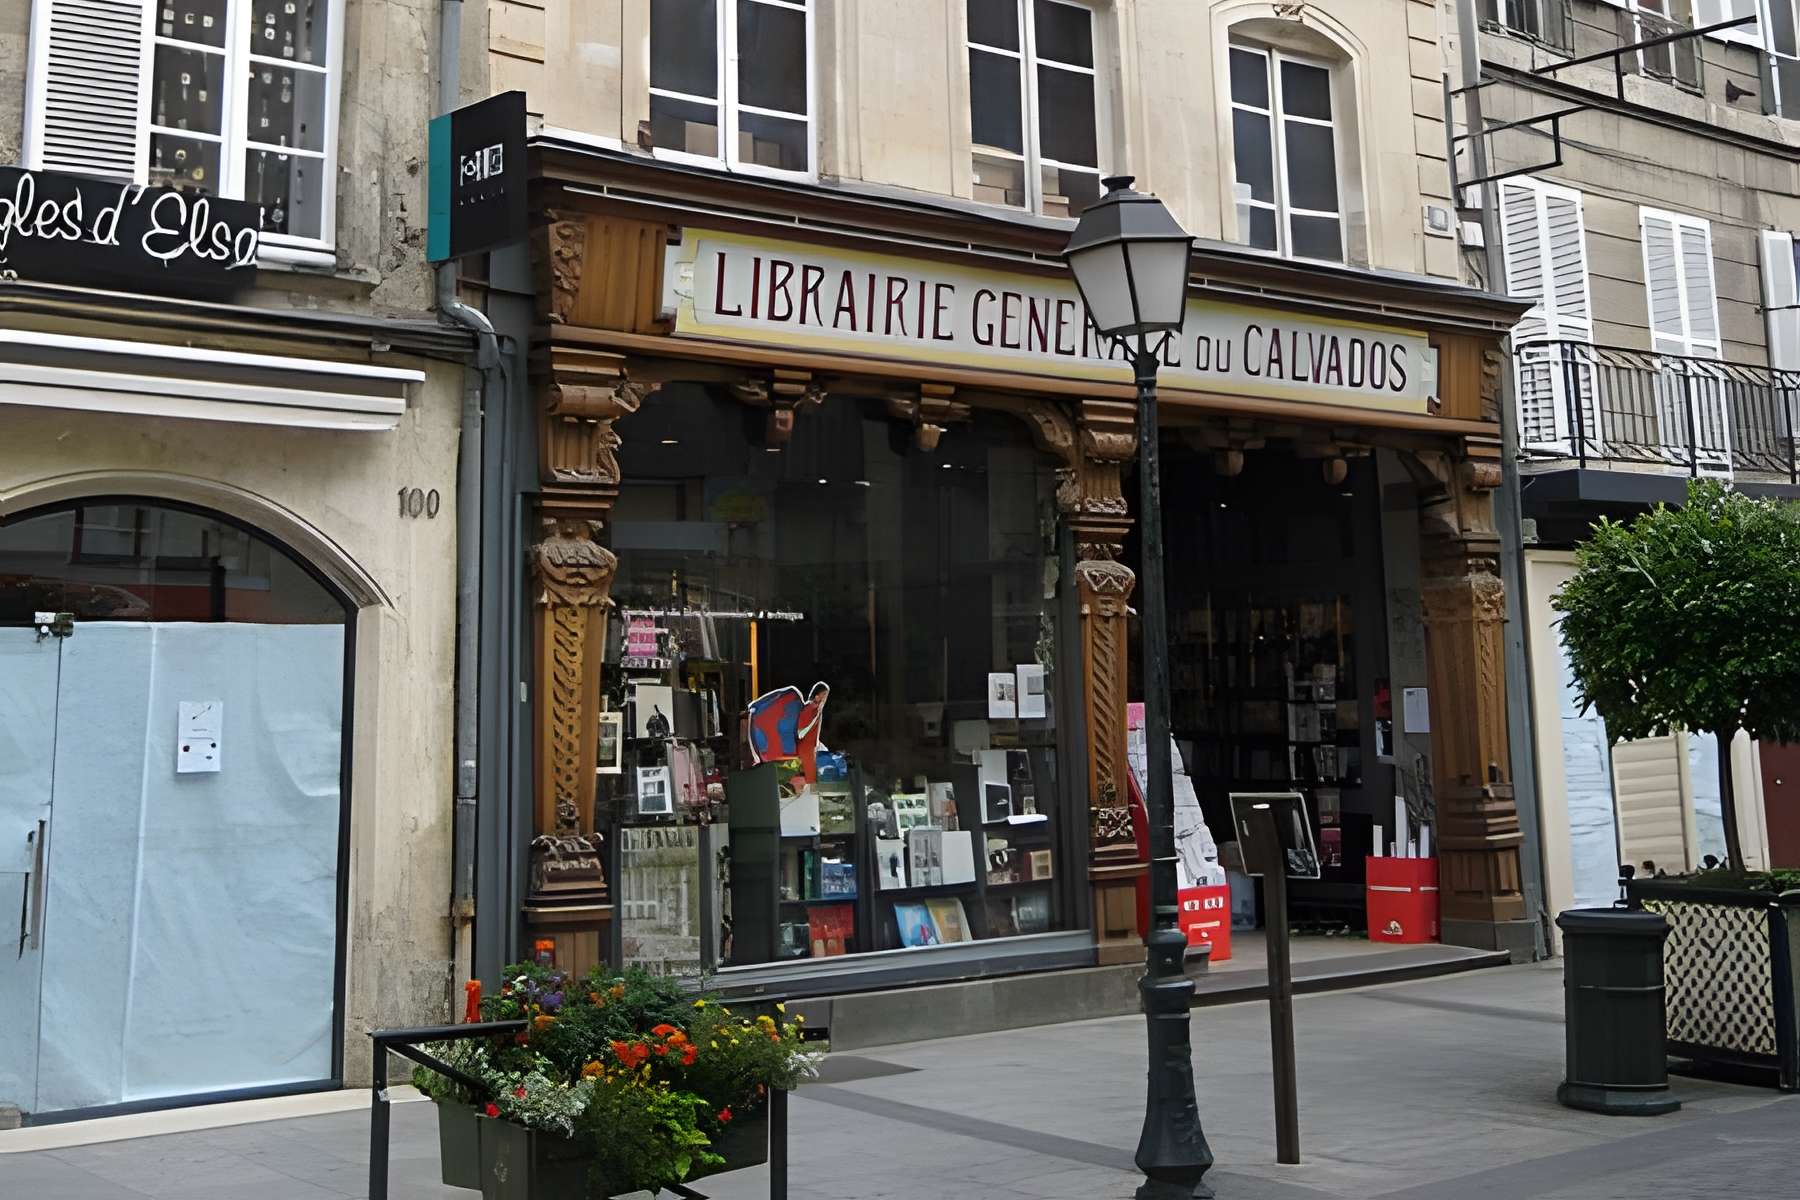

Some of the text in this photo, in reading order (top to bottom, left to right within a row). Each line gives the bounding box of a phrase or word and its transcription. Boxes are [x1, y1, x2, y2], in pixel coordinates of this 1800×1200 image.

[715, 252, 955, 340] LIBRAIRIE
[1244, 324, 1407, 392] CALVADOS
[398, 486, 440, 520] 100
